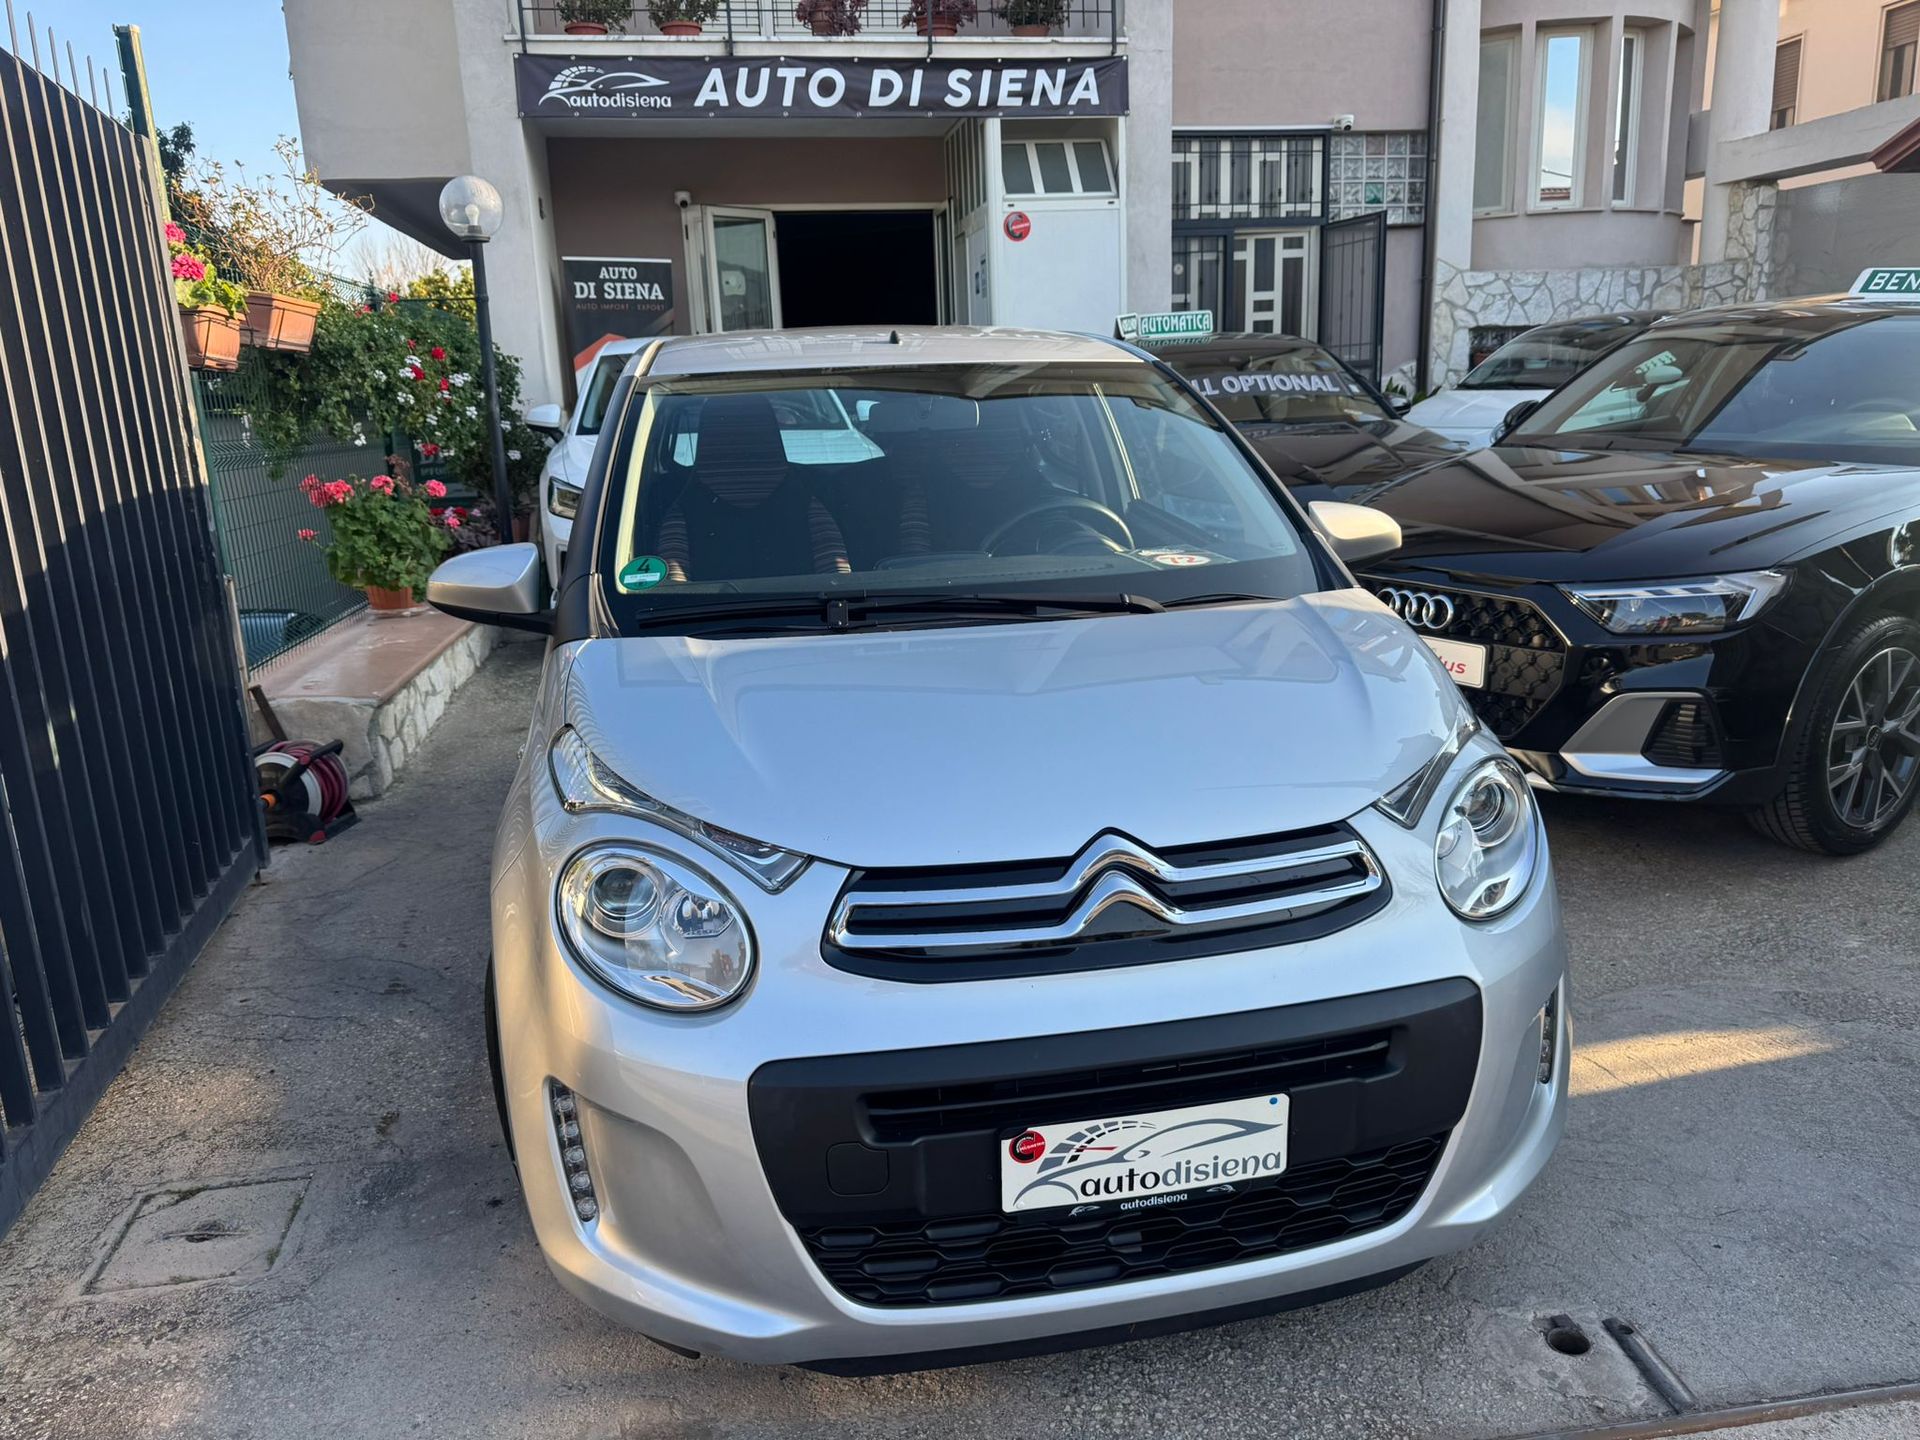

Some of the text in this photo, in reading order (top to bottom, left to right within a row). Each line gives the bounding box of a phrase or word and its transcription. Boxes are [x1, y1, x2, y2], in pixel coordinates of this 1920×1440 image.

[694, 67, 1100, 108] AUTO DI SIENA
[569, 92, 672, 110] autodisiena
[599, 266, 638, 280] AUTO
[573, 281, 665, 300] DI SIENA
[575, 303, 598, 311] AUTO
[1141, 314, 1210, 335] AUTOMATICA
[1221, 374, 1341, 394] OPTIONAL
[637, 558, 651, 574] 4
[1080, 1150, 1281, 1197] autodisiena
[1120, 1193, 1188, 1211] autodisiena
